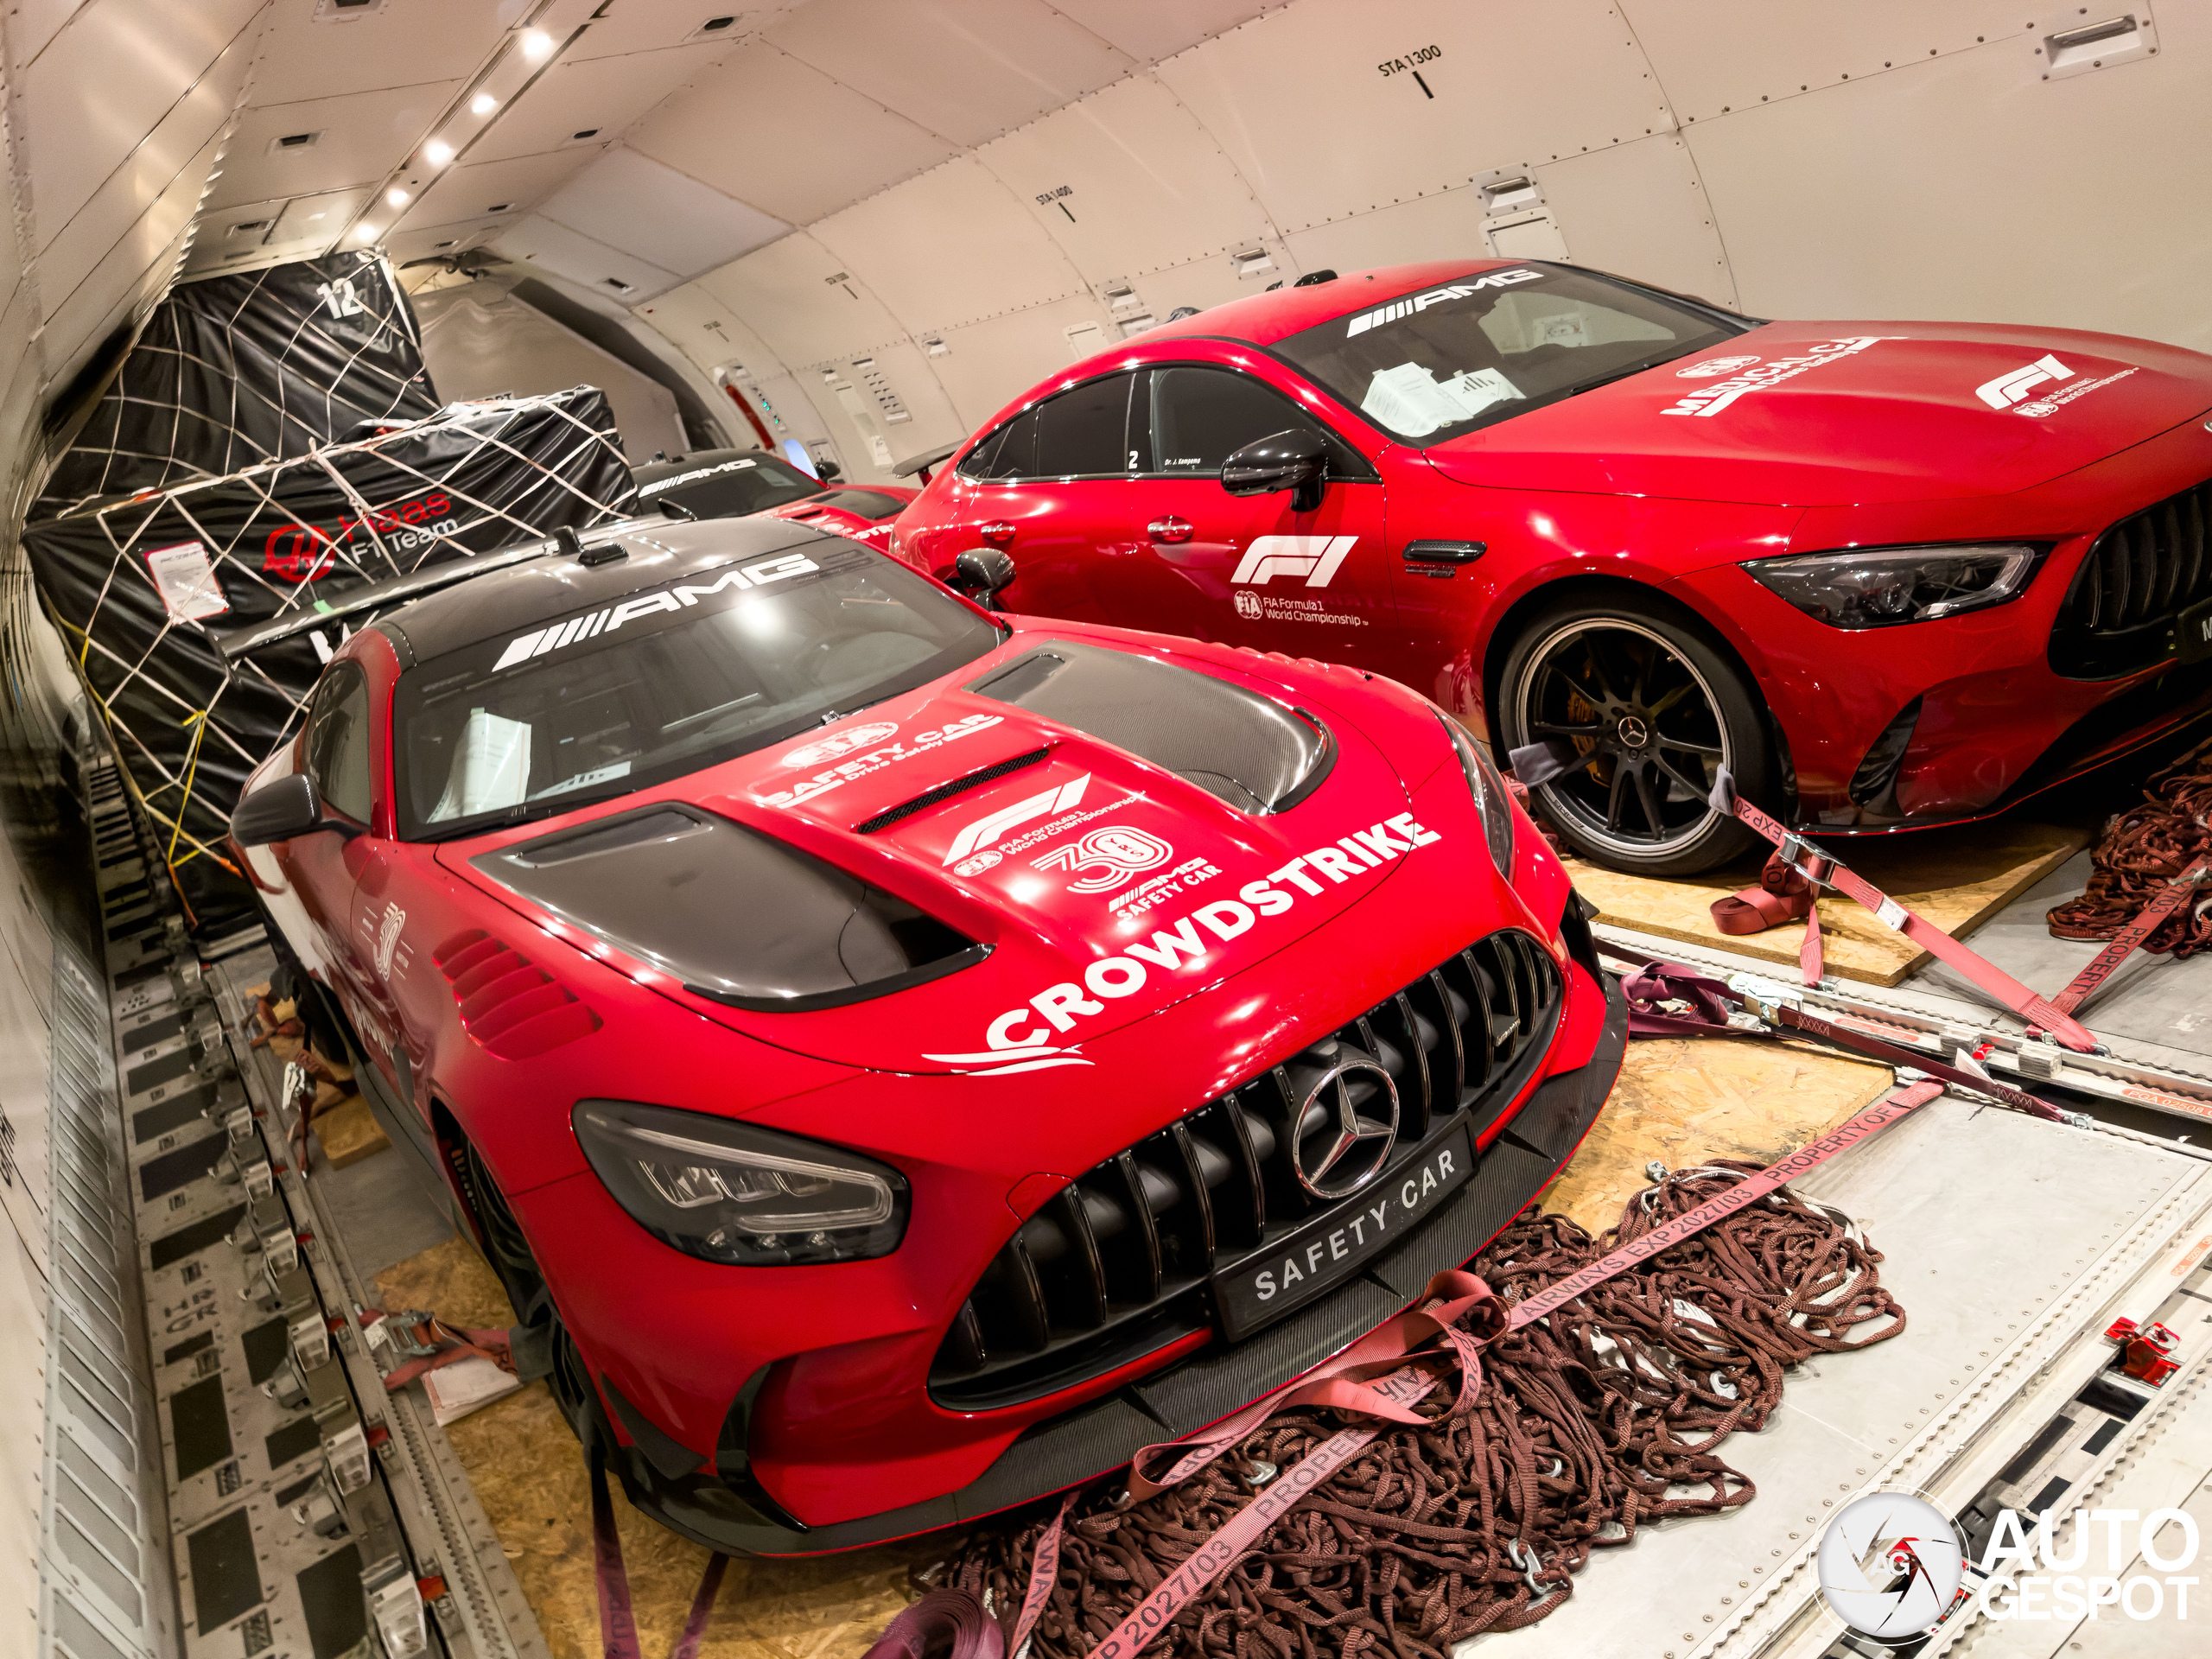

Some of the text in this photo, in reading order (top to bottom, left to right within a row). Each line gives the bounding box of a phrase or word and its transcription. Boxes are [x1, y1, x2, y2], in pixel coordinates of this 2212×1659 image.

[1378, 45, 1441, 77] STA 1300
[316, 277, 363, 320] 12
[1659, 353, 1823, 416] MEDICAL
[1128, 450, 1139, 470] 2
[337, 493, 451, 543] Haas
[351, 518, 458, 564] F1 Team
[1230, 536, 1359, 588] F1
[1263, 597, 1279, 607] FIA
[1279, 598, 1319, 611] Formula
[1266, 608, 1294, 621] World
[1295, 611, 1361, 626] Championship
[764, 714, 995, 804] SAFETY CAR
[843, 739, 944, 781] Drive Safely
[942, 772, 1091, 868] F1
[998, 839, 1024, 853] FIA
[1022, 814, 1080, 842] Formula
[1005, 833, 1048, 855] World
[1046, 795, 1140, 838] Championship
[1753, 816, 1783, 842] EXP
[1029, 826, 1173, 893] 30
[1116, 864, 1223, 920] SAFETY CAR
[986, 811, 1442, 1052] CROWDSTRIKE
[2128, 1090, 2158, 1103] PGA
[1255, 1149, 1455, 1300] SAFETY CAR
[1522, 1106, 1894, 1315] AIRWAYS EXP 2027/03 PROPERTY OF
[1124, 1541, 1233, 1646] 2027/03
